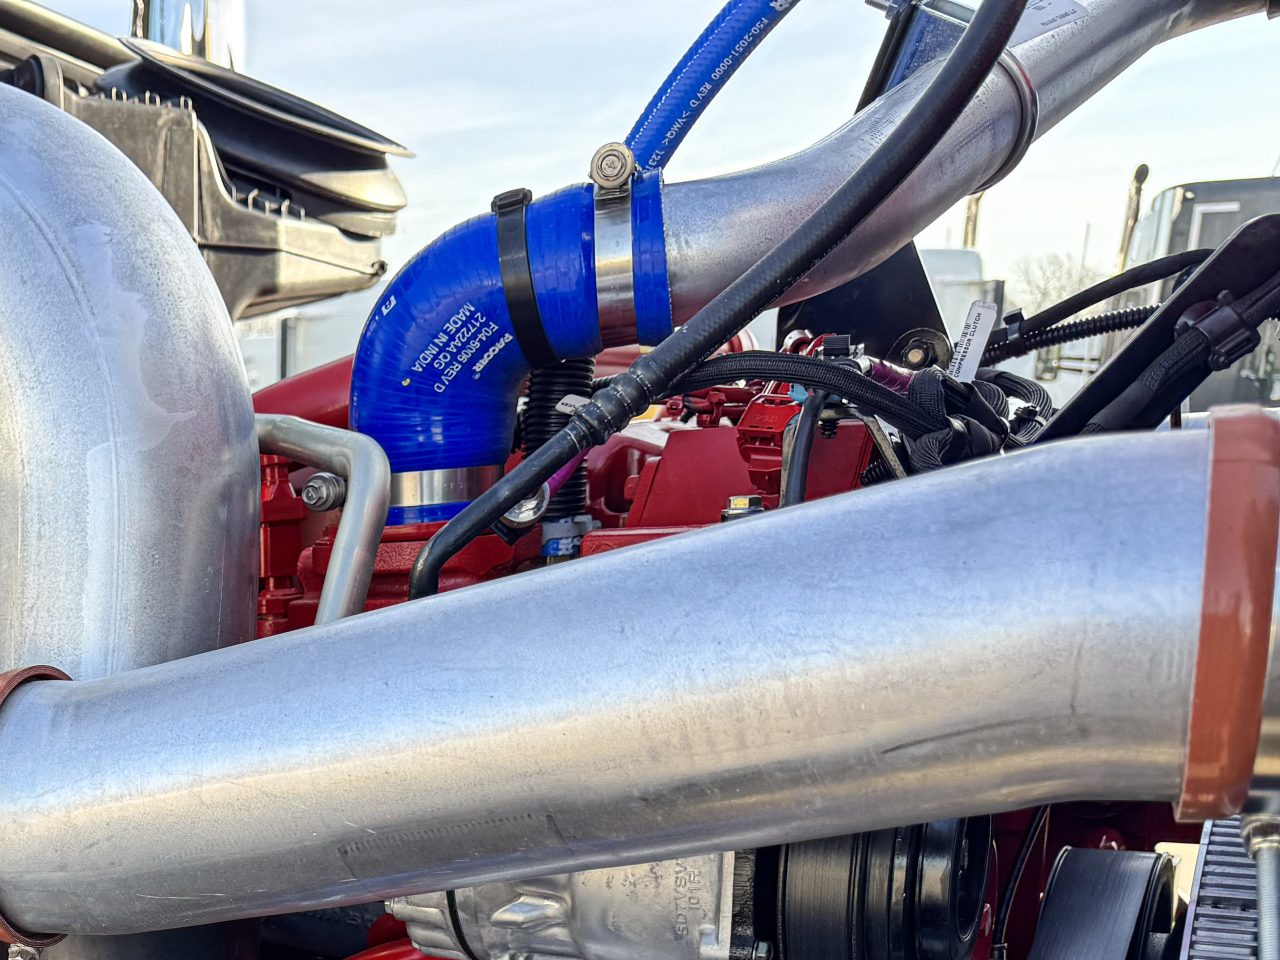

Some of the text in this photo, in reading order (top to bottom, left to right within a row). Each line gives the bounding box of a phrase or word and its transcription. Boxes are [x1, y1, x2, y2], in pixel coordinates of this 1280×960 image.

[712, 17, 768, 80] F50-2051-0000
[696, 82, 712, 100] REV
[409, 301, 475, 374] MADE IN INDIA
[431, 310, 486, 371] 21722AA QG
[432, 320, 499, 394] F04-6006 REV D
[471, 332, 513, 373] PACCAR
[952, 311, 982, 379] COMPRESSOR CLUTCH
